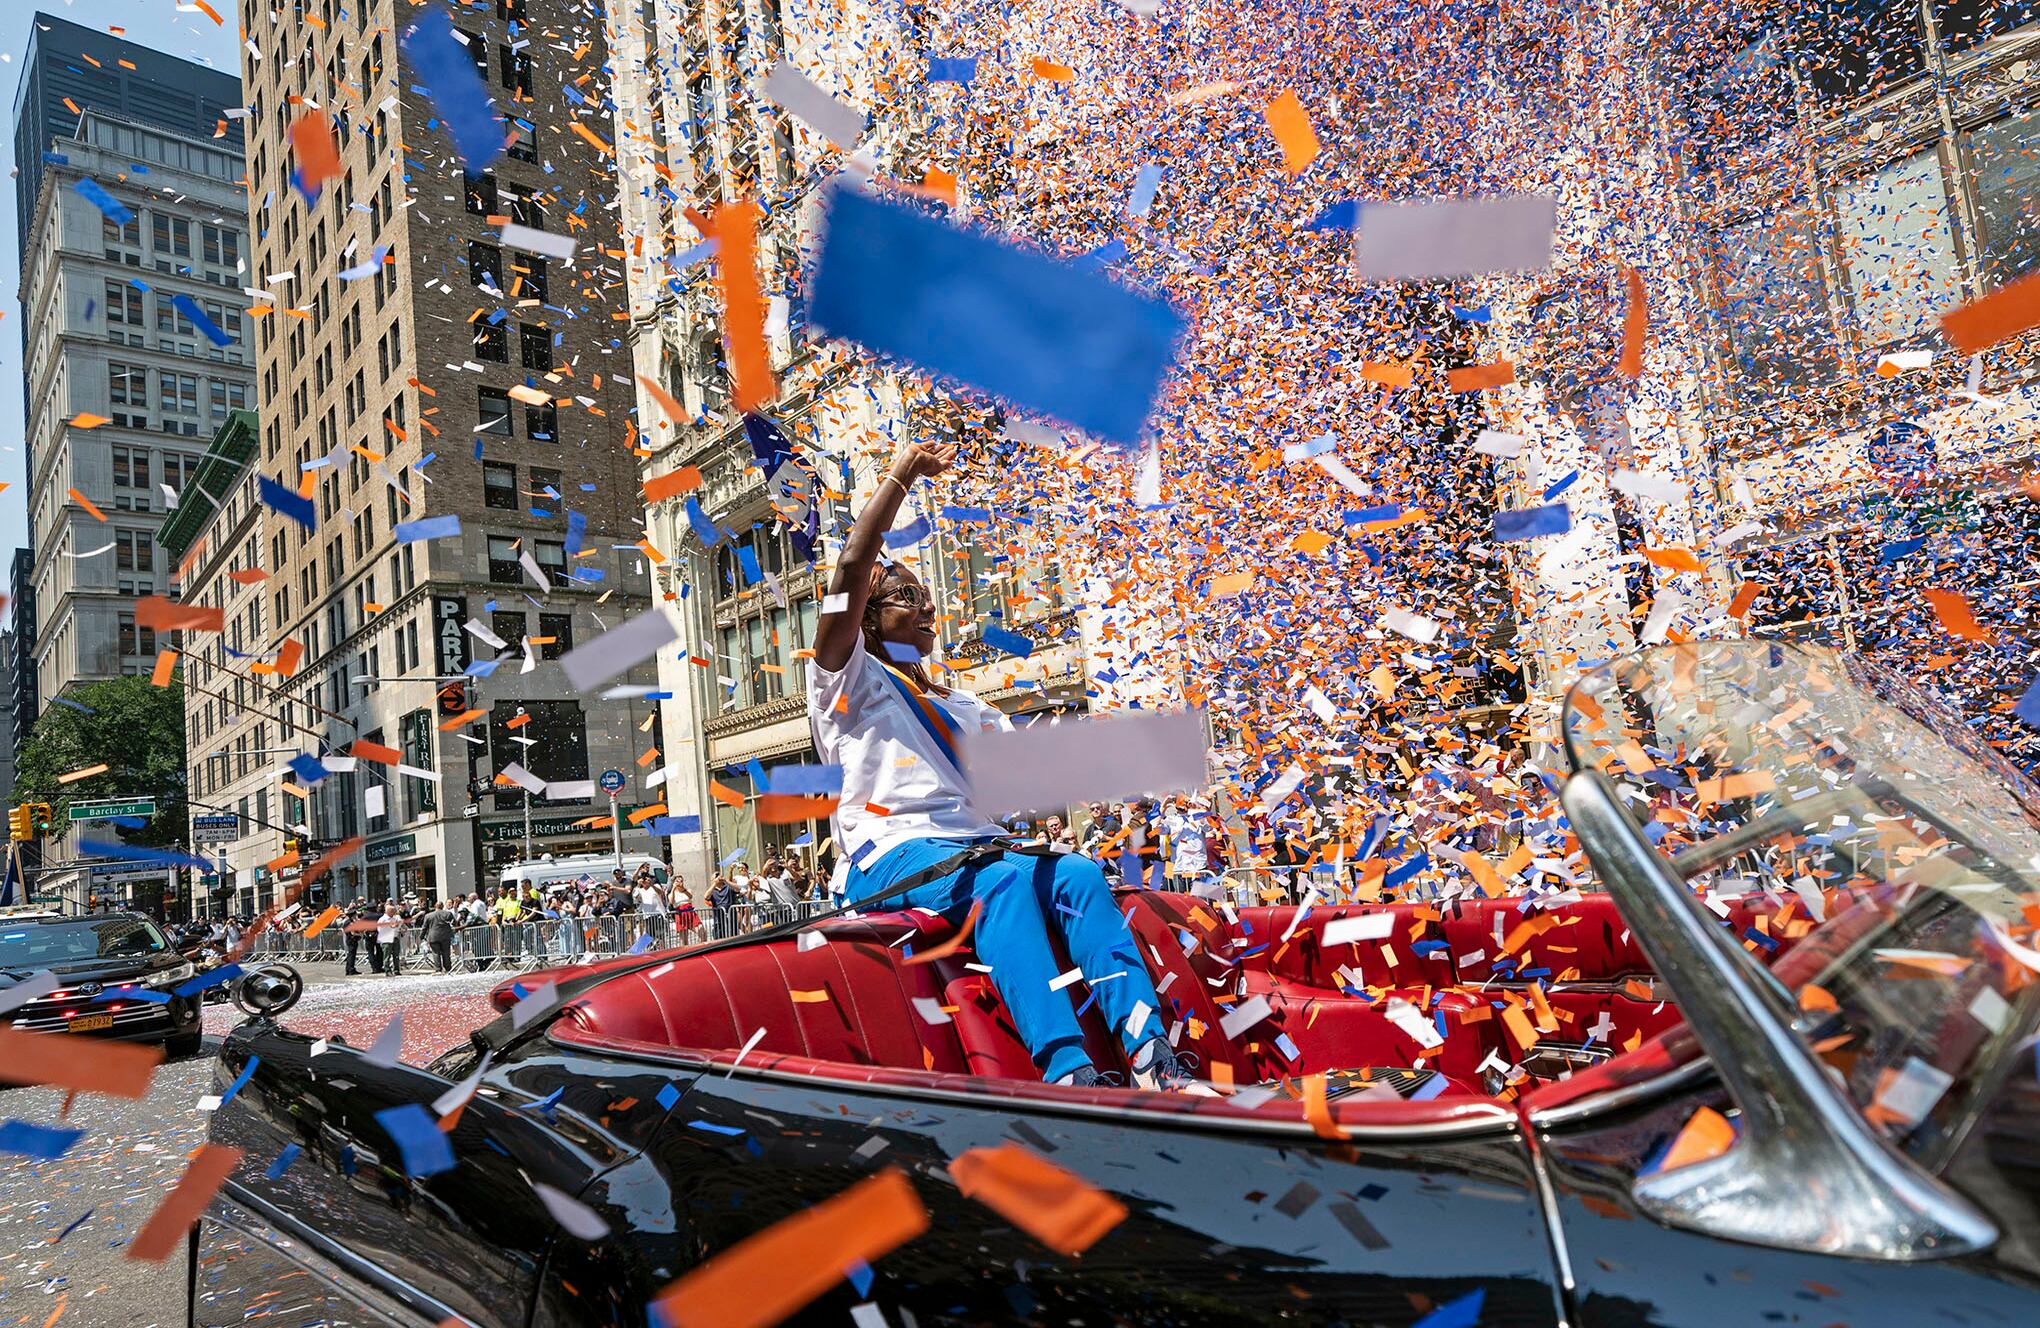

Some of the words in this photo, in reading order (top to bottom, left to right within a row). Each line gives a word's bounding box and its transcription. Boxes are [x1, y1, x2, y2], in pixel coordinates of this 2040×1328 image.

[440, 600, 464, 673] PARK
[419, 714, 428, 749] FIRST
[420, 752, 432, 805] REBLIC
[89, 807, 124, 816] Barclay
[127, 805, 136, 813] St
[499, 825, 525, 837] FIRS
